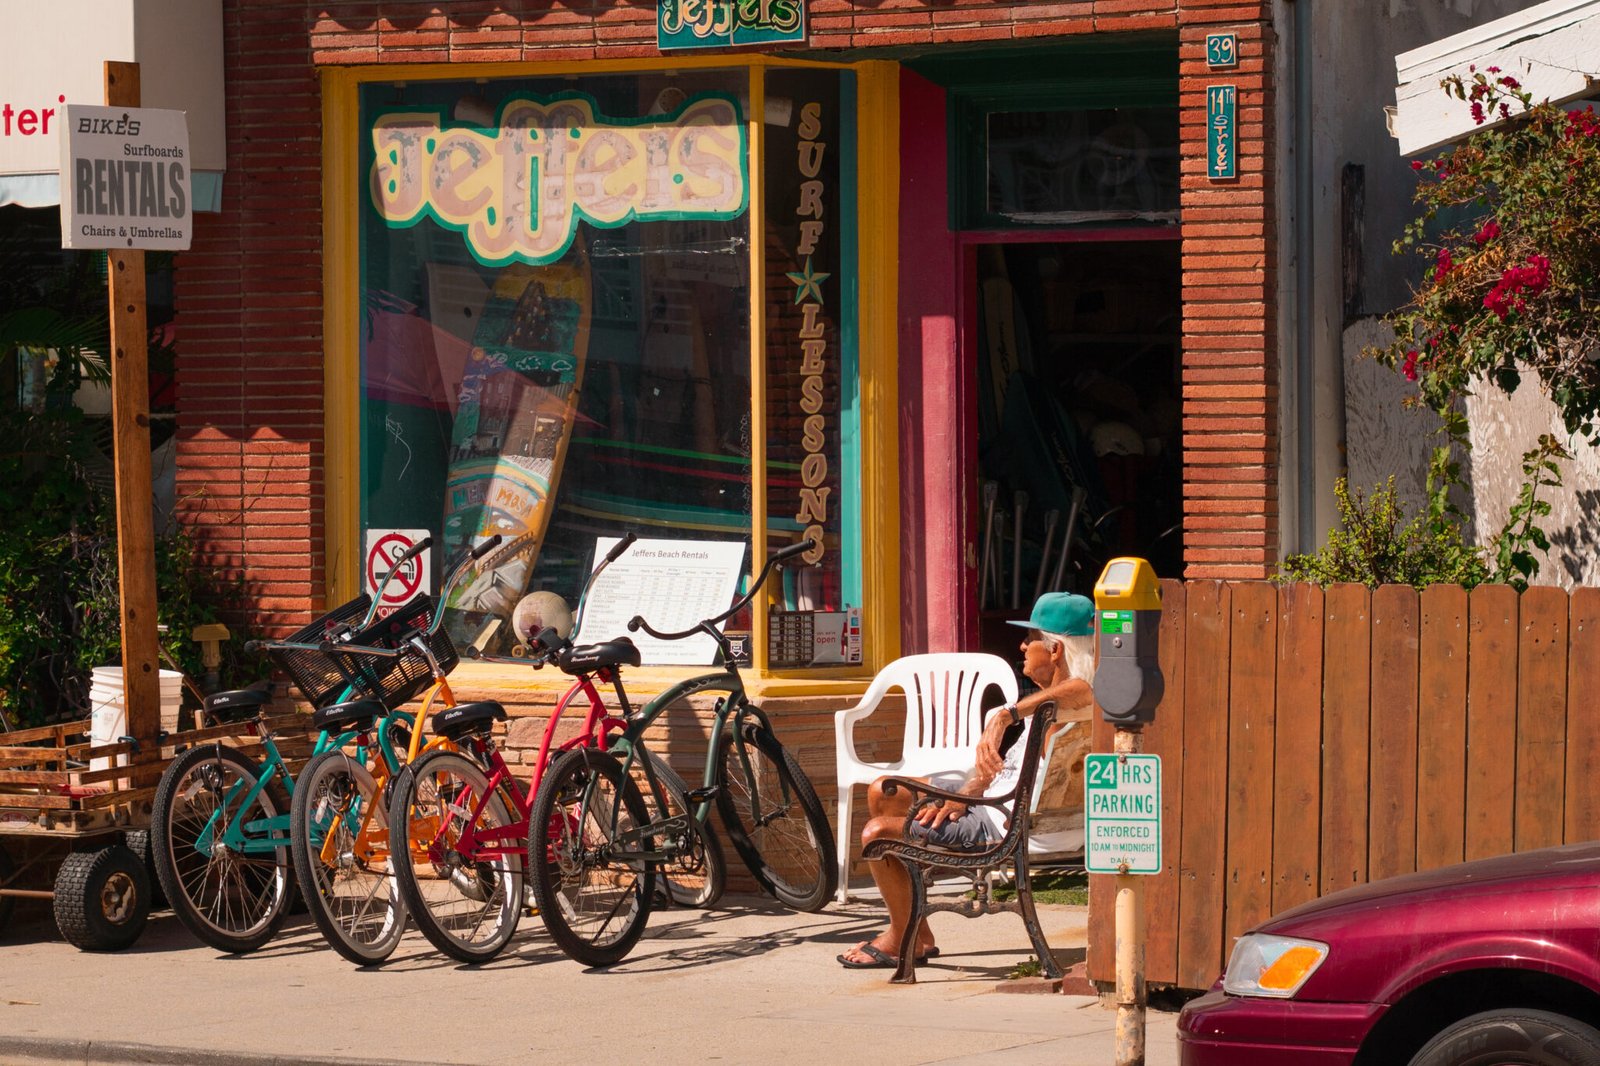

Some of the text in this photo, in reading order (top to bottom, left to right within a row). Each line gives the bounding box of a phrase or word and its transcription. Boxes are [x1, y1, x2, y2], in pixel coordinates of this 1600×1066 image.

[1209, 37, 1233, 63] 39
[3, 94, 65, 136] ter
[78, 118, 141, 136] BIKES
[124, 143, 184, 158] Surfboards
[372, 99, 741, 255] Jeffers
[76, 158, 186, 219] RENTALS
[81, 225, 183, 239] Chairs & Umbrellas
[796, 102, 831, 564] SURF LESSONS
[632, 549, 709, 559] Jeffers Beach Rentals
[816, 636, 836, 645] open
[1089, 760, 1152, 785] 24 HRS
[1093, 794, 1153, 814] PARKING
[1096, 826, 1150, 838] ENFORCED
[1119, 843, 1155, 852] MIDNIGHT
